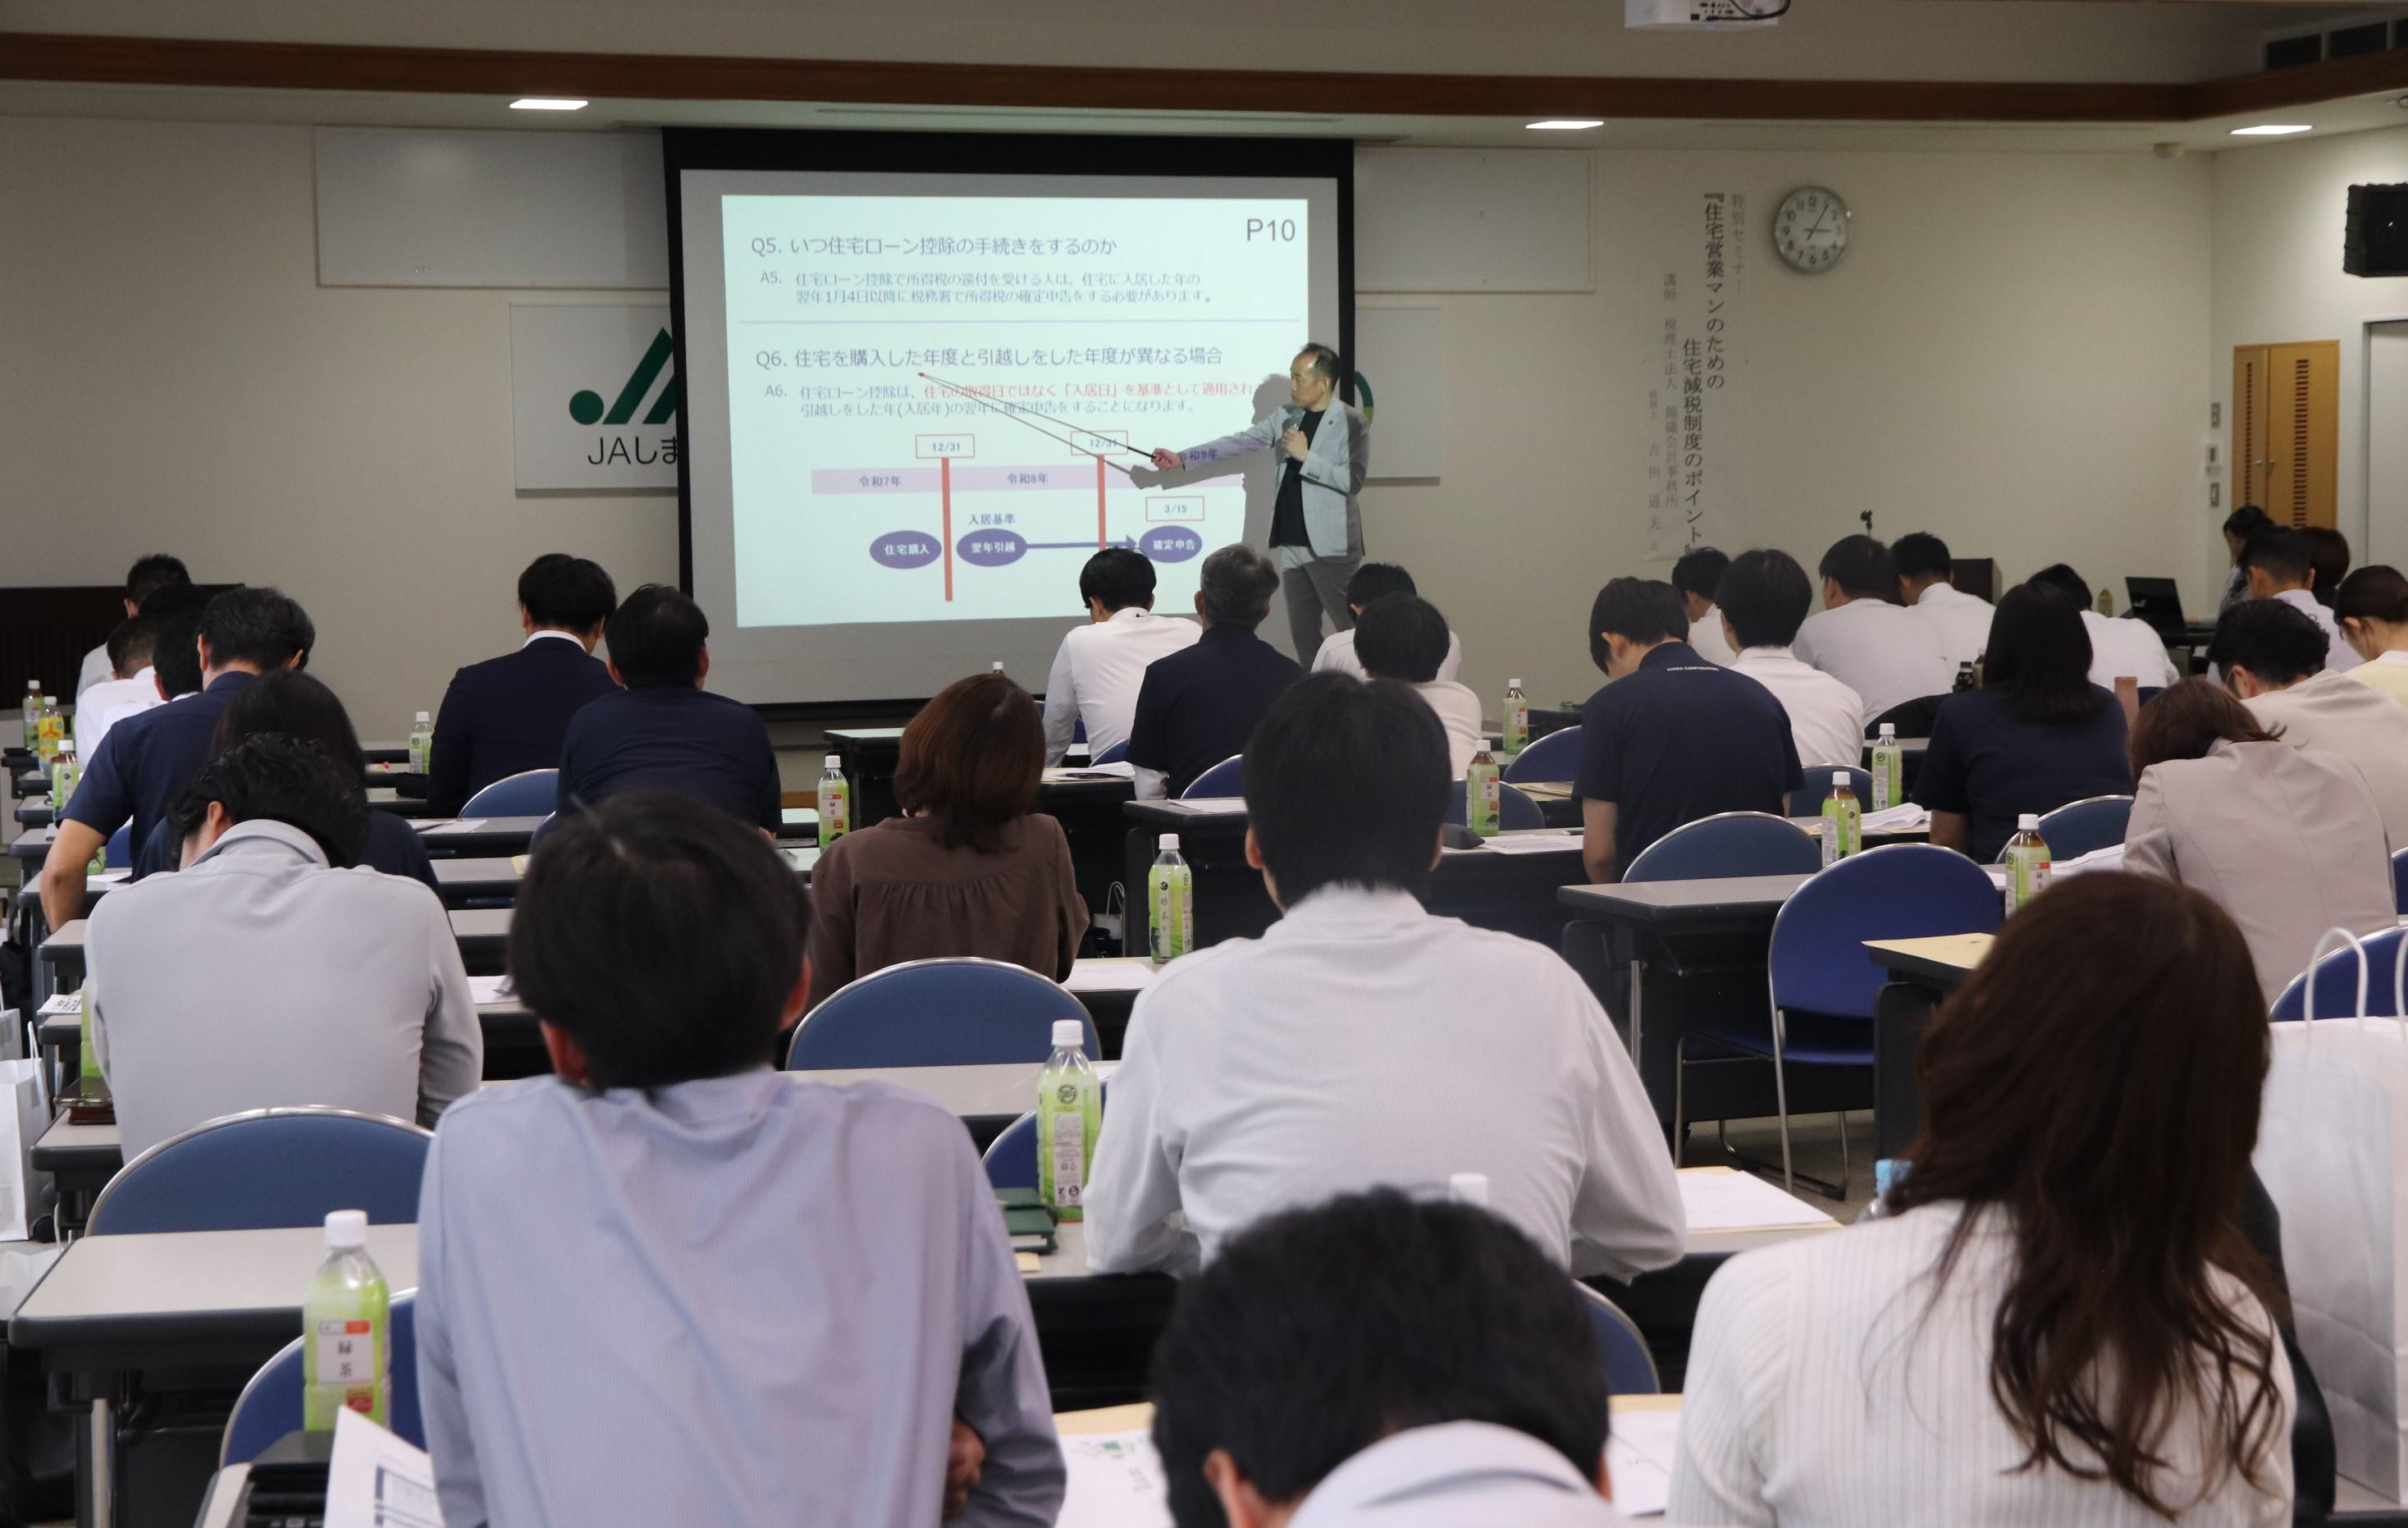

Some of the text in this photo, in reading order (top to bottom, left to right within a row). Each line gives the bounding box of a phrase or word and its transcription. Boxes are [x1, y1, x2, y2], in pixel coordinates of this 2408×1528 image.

[1246, 218, 1295, 241] P10
[751, 236, 1117, 257] Q5. いつ住宅ローン控除の手続きをするのか
[761, 272, 1200, 287] A5. 住宅ローン控除で所得税の還付を受ける人は、住宅に入居した年の
[797, 289, 1212, 304] 翌年1月4日以降に税務署で所得税の確定申告をする必要があります。
[1703, 192, 1725, 389] 『住宅営業マンのための
[756, 347, 1222, 370] Q6. 住宅を購入した年度と引越しをした年度が異なる場合
[765, 383, 1257, 400] A6. 住宅ローン控除は、住宅の取得日ではなく「入居日」を基準として適用され
[587, 435, 678, 465] JAしま
[932, 442, 961, 451] 12/31
[860, 474, 902, 487] 令和7年
[1008, 472, 1049, 484] 令和8年
[1164, 504, 1187, 514] 3/15
[968, 514, 1015, 525] 入居基準
[884, 542, 930, 556] 住宅購入
[971, 541, 1016, 554] 翌年引越
[1153, 538, 1196, 551] 確定申告
